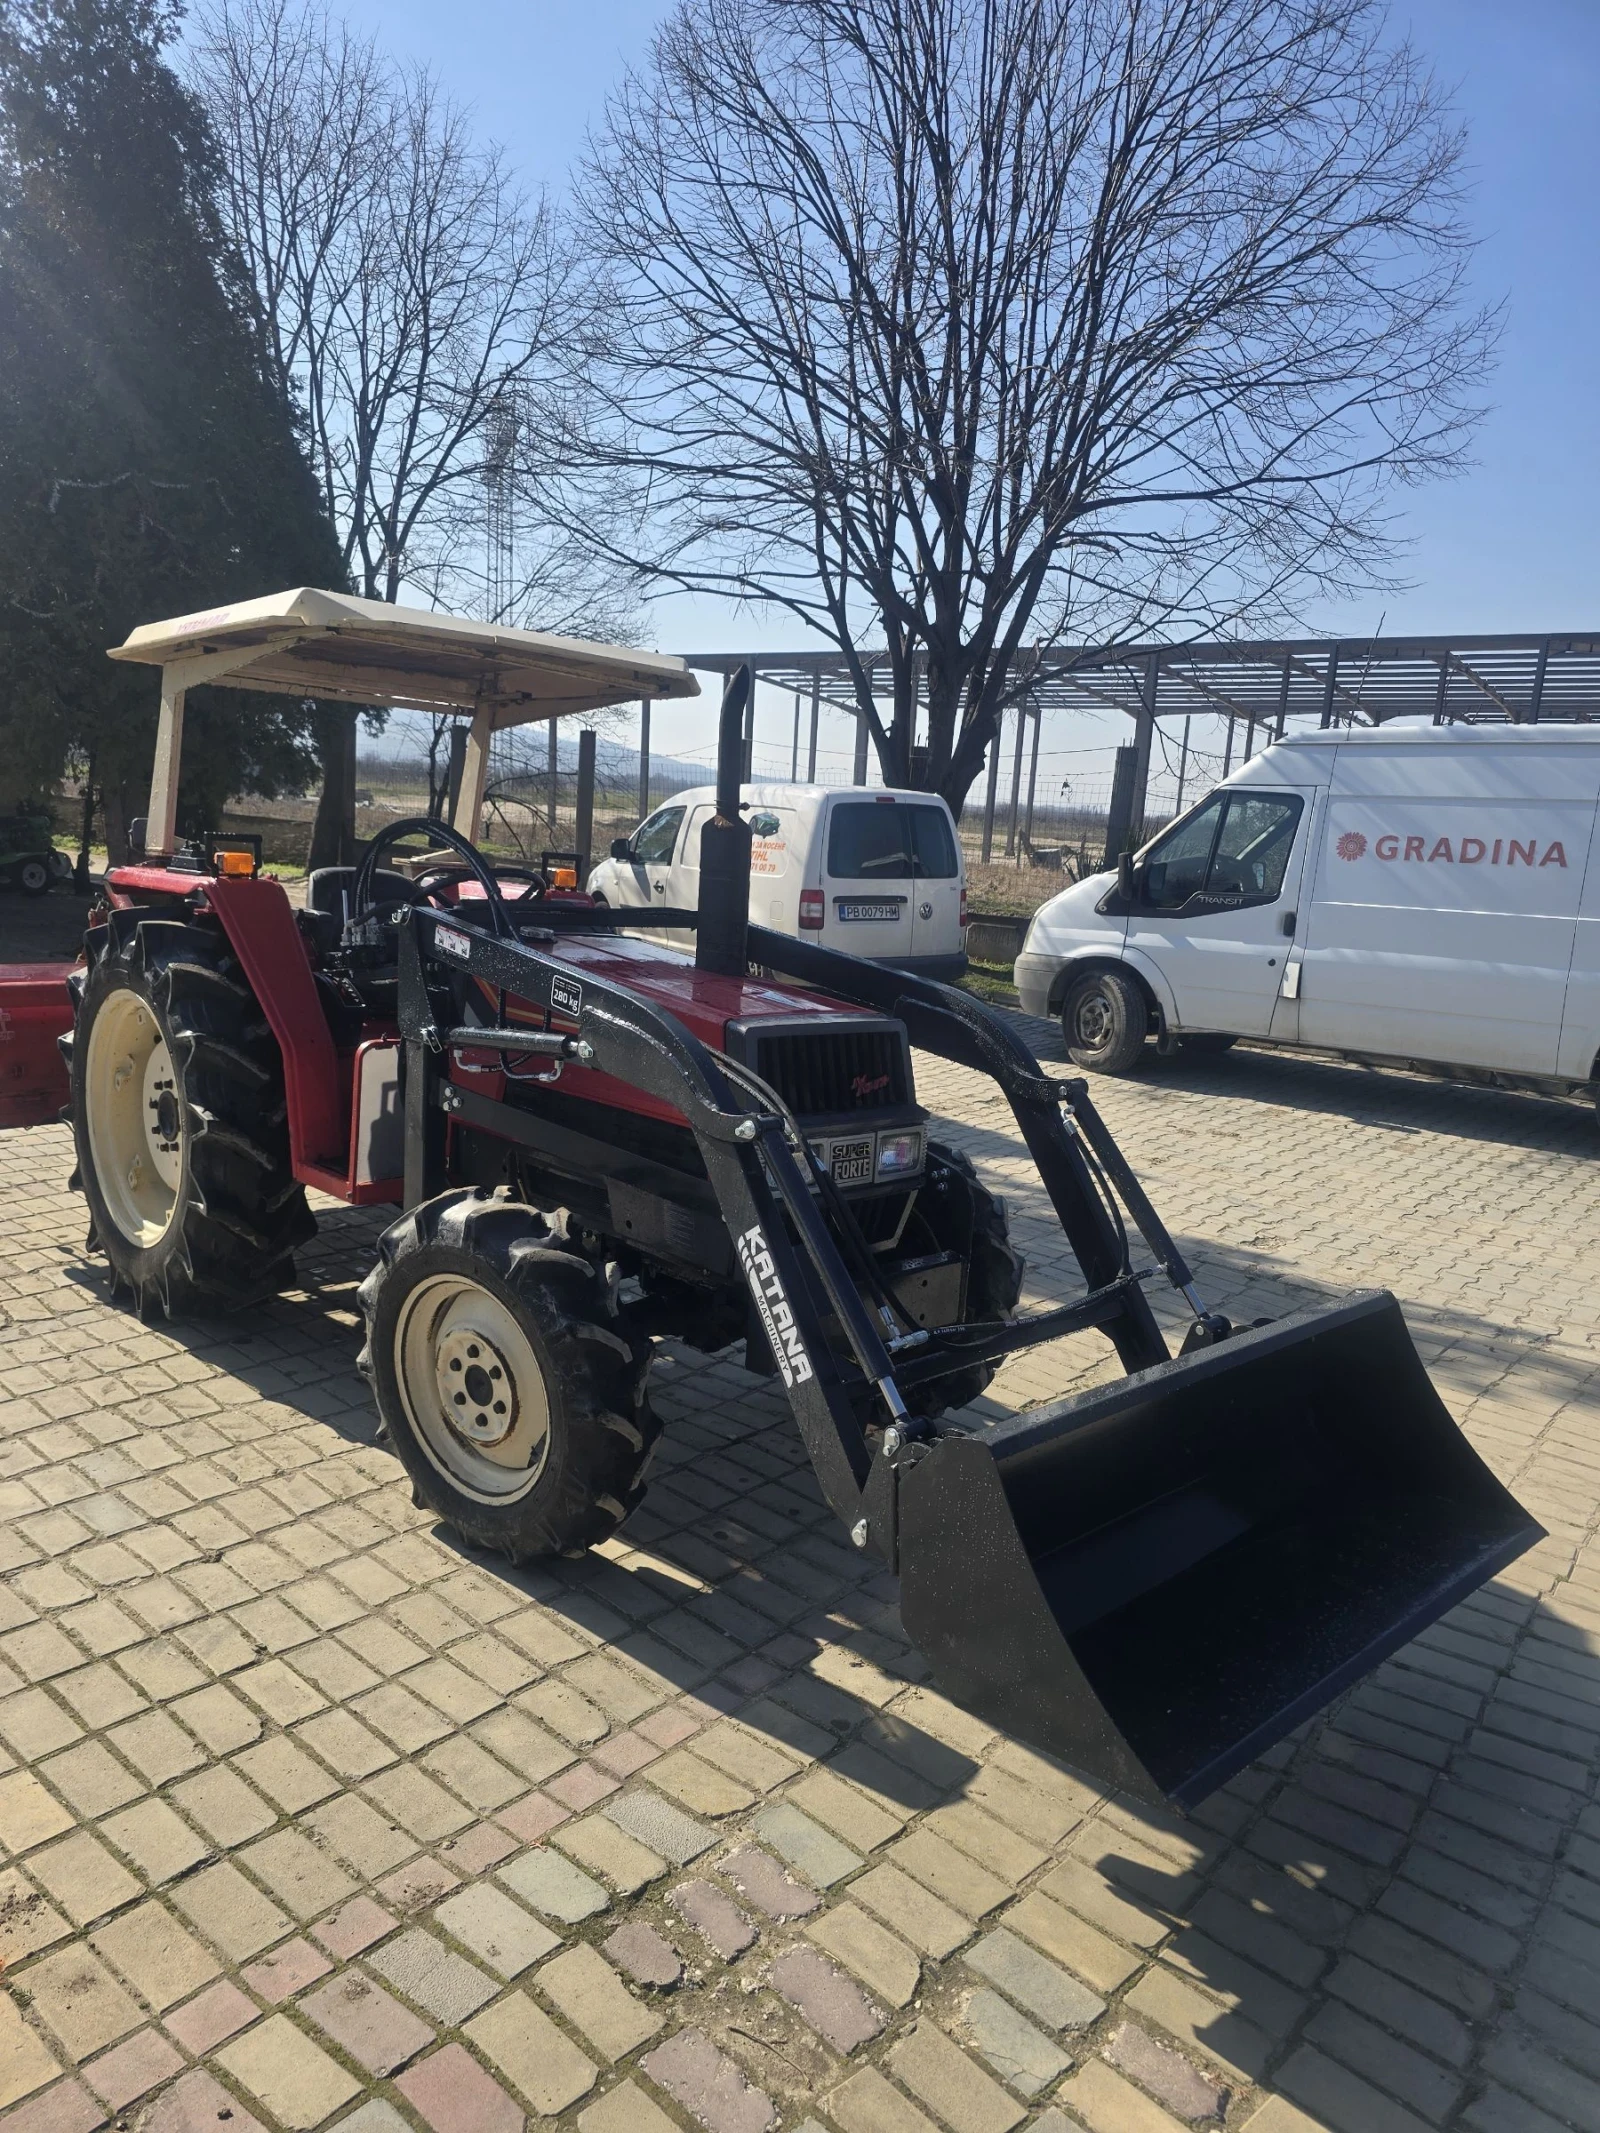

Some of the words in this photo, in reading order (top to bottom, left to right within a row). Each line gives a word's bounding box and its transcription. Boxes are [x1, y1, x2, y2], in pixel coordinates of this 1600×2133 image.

[751, 851, 768, 861] TIHL
[1375, 835, 1568, 868] GRADINA
[1200, 896, 1244, 905] TRANSIT
[553, 989, 568, 1004] 280
[569, 995, 579, 1011] kg
[833, 1143, 871, 1159] SUPER
[834, 1159, 870, 1180] FORTE
[744, 1224, 813, 1384] KATANA
[756, 1295, 790, 1371] MACHINERY
